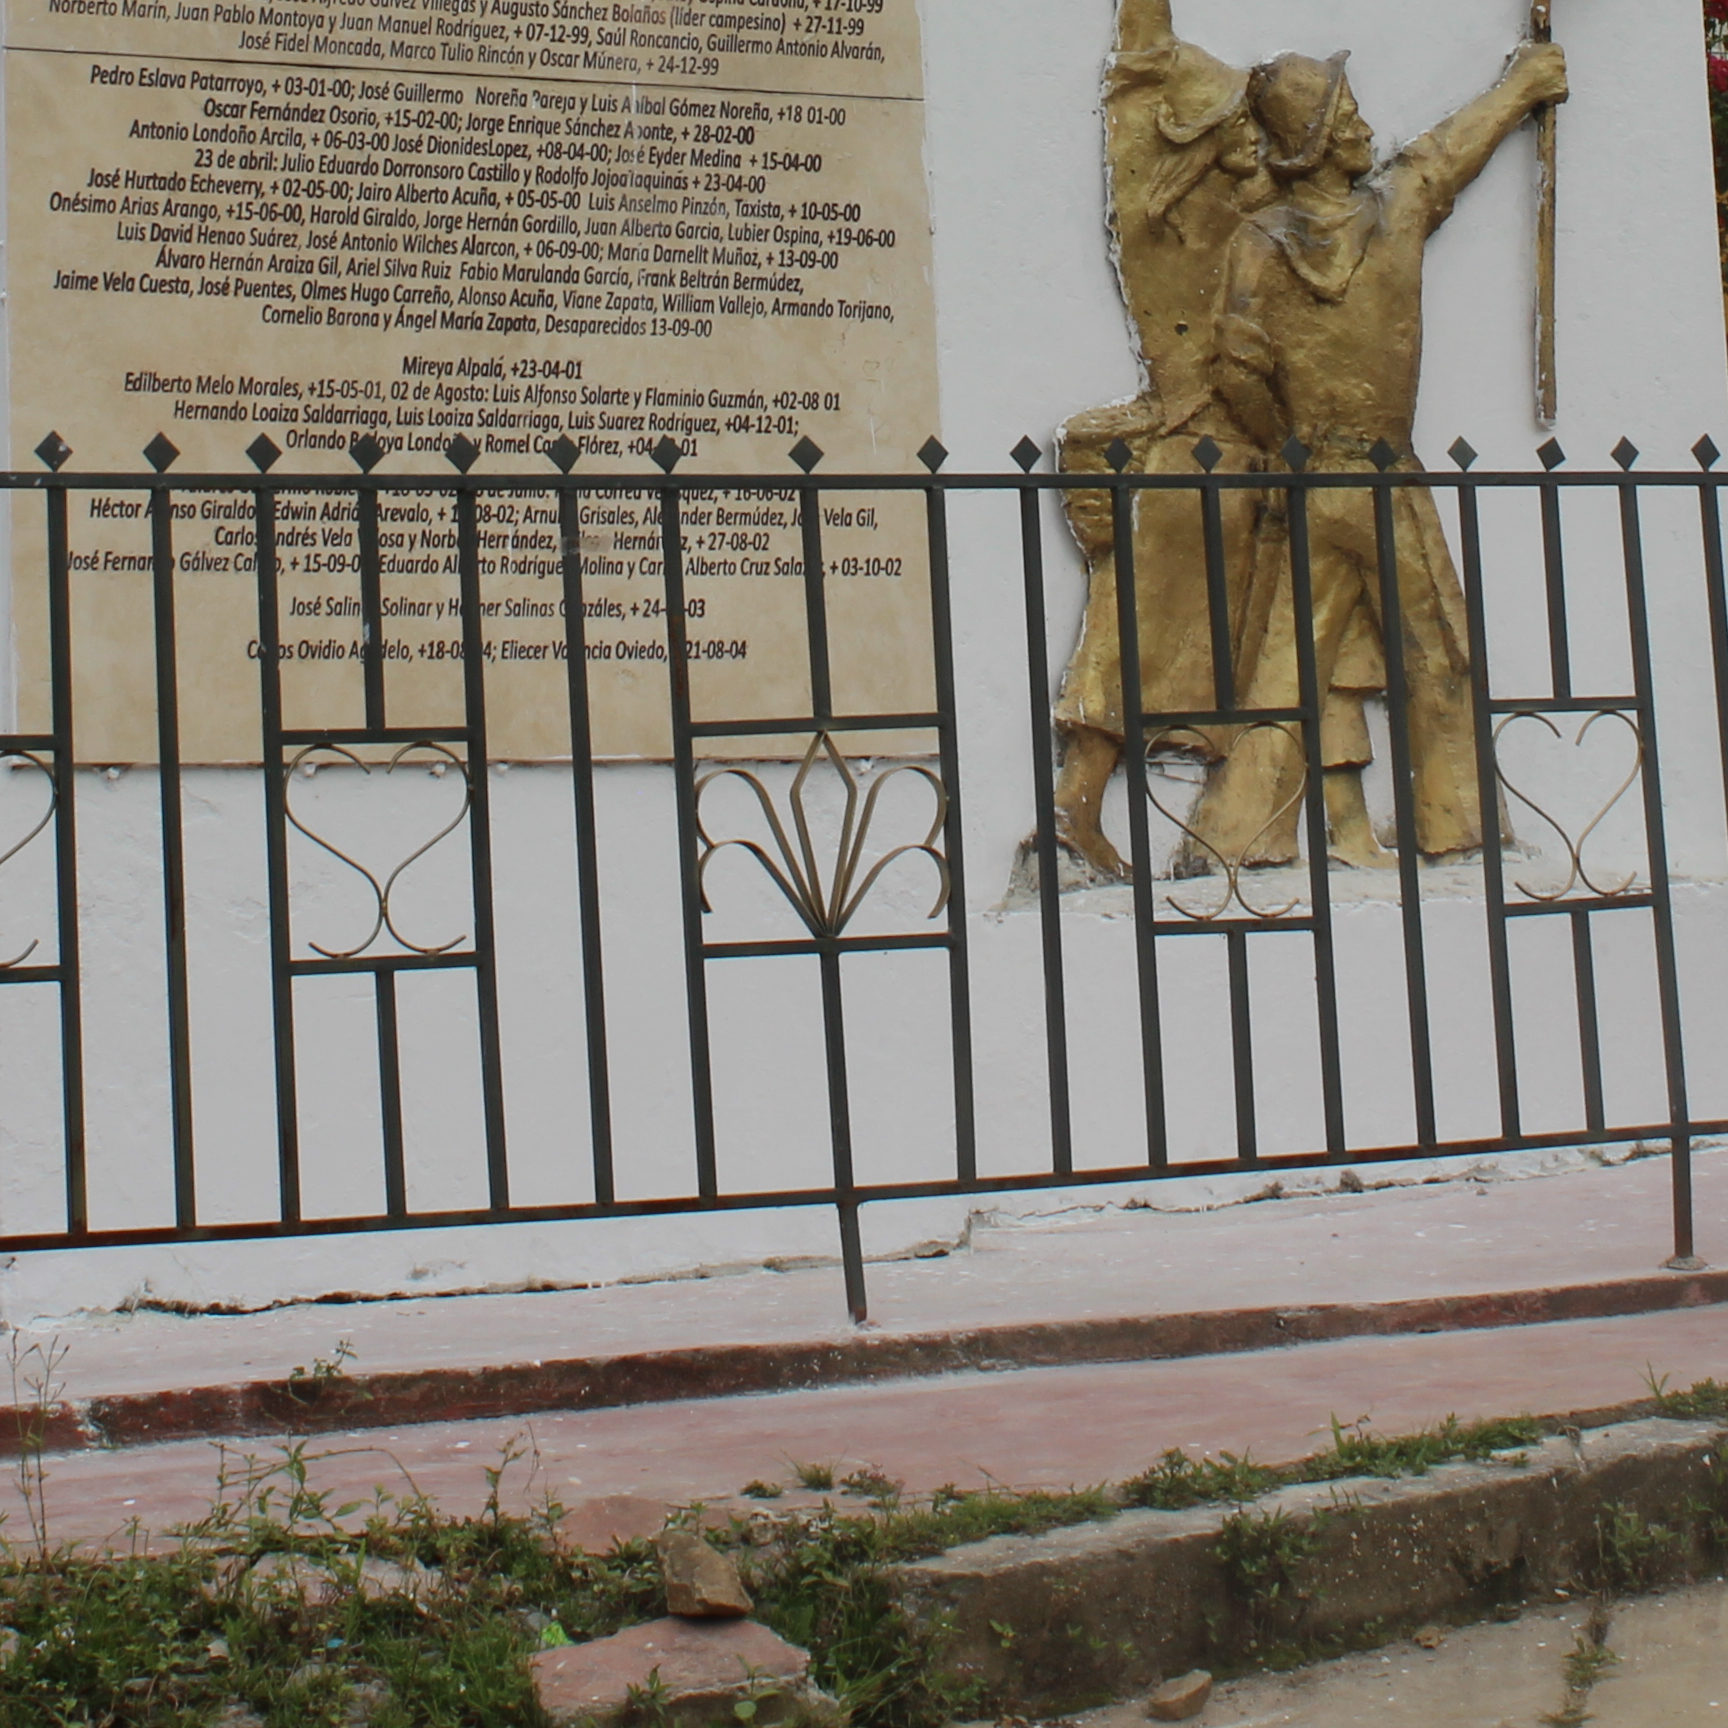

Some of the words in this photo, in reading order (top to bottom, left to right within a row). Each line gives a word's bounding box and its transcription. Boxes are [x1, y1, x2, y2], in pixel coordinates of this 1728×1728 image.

[174, 1, 209, 21] Juan
[213, 3, 254, 24] Pablo
[258, 6, 324, 32] Montoya
[328, 15, 336, 33] y
[339, 11, 373, 31] Juan
[377, 14, 432, 35] Manuel
[435, 17, 509, 42] Rodríguez,
[525, 22, 592, 48] 07-12-99,
[595, 26, 626, 46] Saúl
[629, 28, 702, 54] Roncancio,
[706, 33, 772, 54] Guillermo
[775, 37, 828, 57] Antonio
[829, 39, 885, 64] Alvarán,
[49, 191, 116, 214] Onésimo
[118, 195, 159, 216] Arias
[161, 197, 221, 223] Arango,
[225, 201, 305, 226] +15-06-00,
[309, 204, 360, 225] Harold
[363, 207, 419, 231] Giraldo,
[422, 209, 462, 234] Jorge
[466, 211, 518, 232] Hernán
[521, 213, 580, 238] Gordillo,
[583, 217, 616, 235] Juan
[619, 217, 671, 238] Alberto
[727, 222, 770, 242] Lubier
[773, 224, 823, 248] Ospina,
[827, 227, 895, 248] +19-06-00
[52, 269, 98, 291] Jaime
[102, 271, 135, 292] Vela
[138, 272, 193, 298] Cuesta,
[196, 275, 230, 296] José
[232, 277, 296, 302] Puentes,
[300, 279, 346, 301] Olmes
[350, 282, 389, 306] Hugo
[392, 283, 453, 308] Carreño,
[457, 285, 506, 306] Alonso
[508, 287, 557, 311] Acuña,
[604, 291, 657, 314] Zapata,
[662, 292, 714, 314] William
[718, 294, 767, 318] Vallejo,
[770, 297, 834, 318] Armando
[836, 299, 894, 322] Torijano,
[401, 355, 453, 380] Mireya
[455, 355, 506, 381] Alpalá,
[509, 358, 582, 379] +23-04-01
[740, 556, 770, 577] Cruz
[841, 556, 902, 578] 03-10-02
[289, 596, 322, 617] José
[381, 596, 433, 617] Solinar
[504, 598, 555, 618] Salinas
[298, 639, 345, 660] Ovidio
[501, 640, 549, 660] Eliecer
